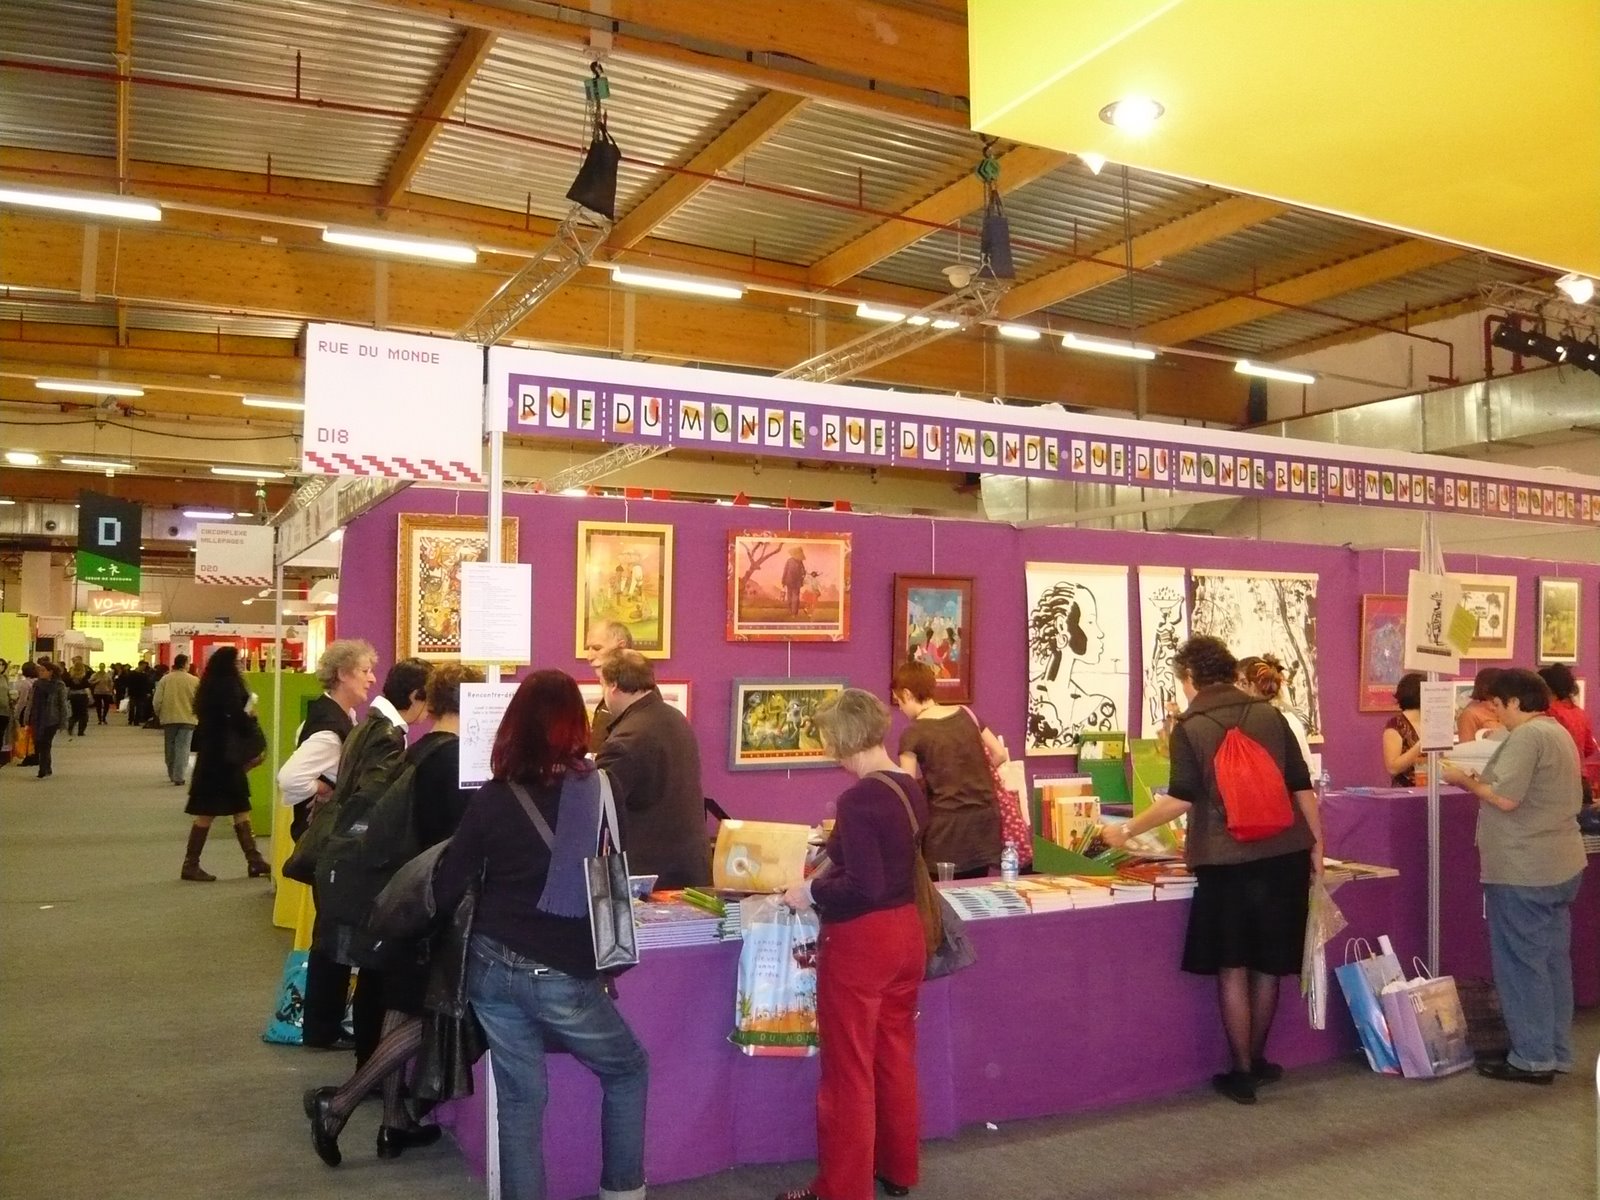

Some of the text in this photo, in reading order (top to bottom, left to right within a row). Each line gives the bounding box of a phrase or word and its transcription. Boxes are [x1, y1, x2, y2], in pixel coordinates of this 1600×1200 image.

[318, 340, 440, 364] RUE DU MONDE
[317, 427, 349, 444] D18
[522, 393, 592, 421] RUE
[616, 402, 660, 427] DU
[681, 409, 803, 441] MONDE
[826, 422, 883, 448] RUE
[903, 430, 939, 452] DU
[956, 435, 1057, 464] MONDE
[1074, 447, 1121, 470] RUE
[1137, 453, 1167, 473] DU
[1180, 457, 1264, 483] MONDE
[1277, 467, 1317, 488] RUE
[1329, 472, 1354, 491] DU
[1365, 474, 1434, 499] MONDE
[1446, 484, 1478, 503] RUE
[1488, 489, 1508, 506] DU
[1518, 490, 1574, 515] MONDE
[98, 517, 121, 546] D
[200, 537, 245, 545] MILLEPAGES
[200, 564, 219, 572] D20
[94, 598, 140, 611] VO-VF
